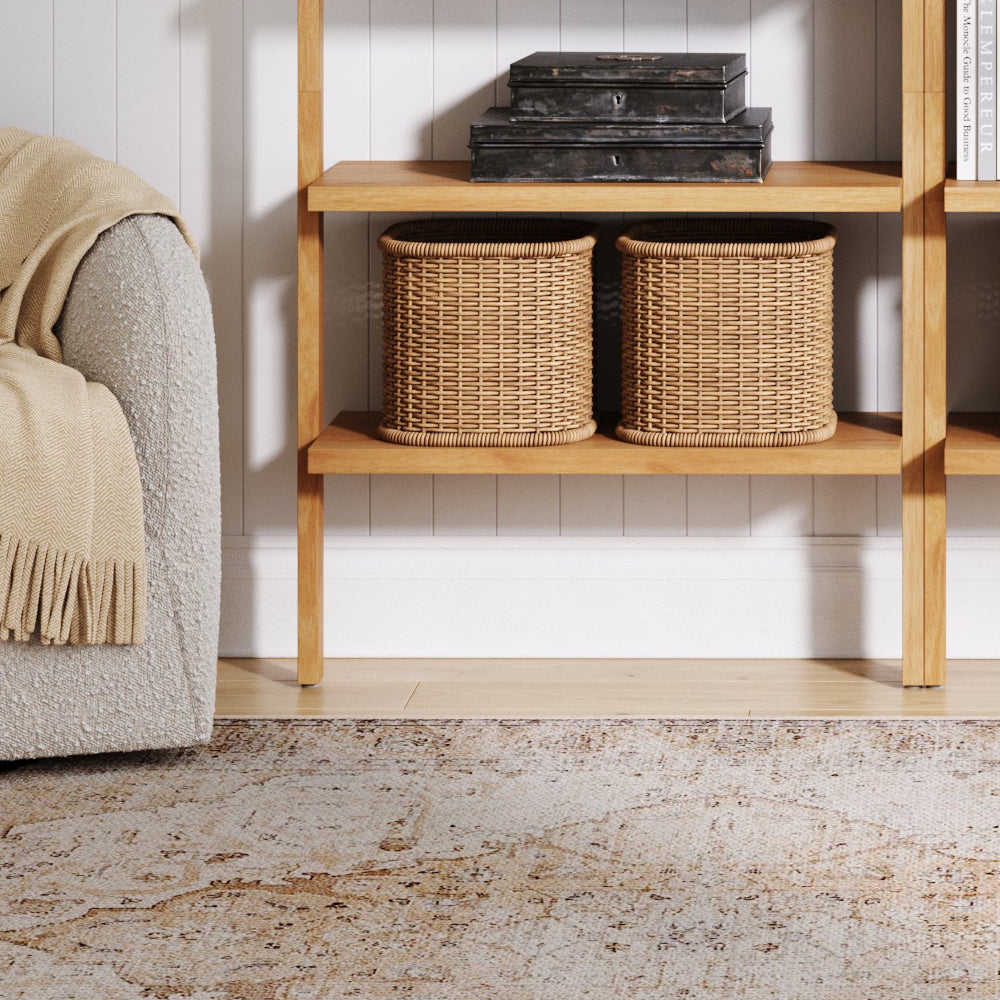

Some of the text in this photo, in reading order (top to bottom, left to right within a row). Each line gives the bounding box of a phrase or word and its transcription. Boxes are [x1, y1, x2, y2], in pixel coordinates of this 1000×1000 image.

[963, 16, 971, 56] Monocle
[963, 56, 971, 84] Guide
[980, 10, 993, 153] LEMPEREUR
[963, 85, 971, 94] to
[963, 95, 971, 122] Good
[963, 124, 971, 162] Business
